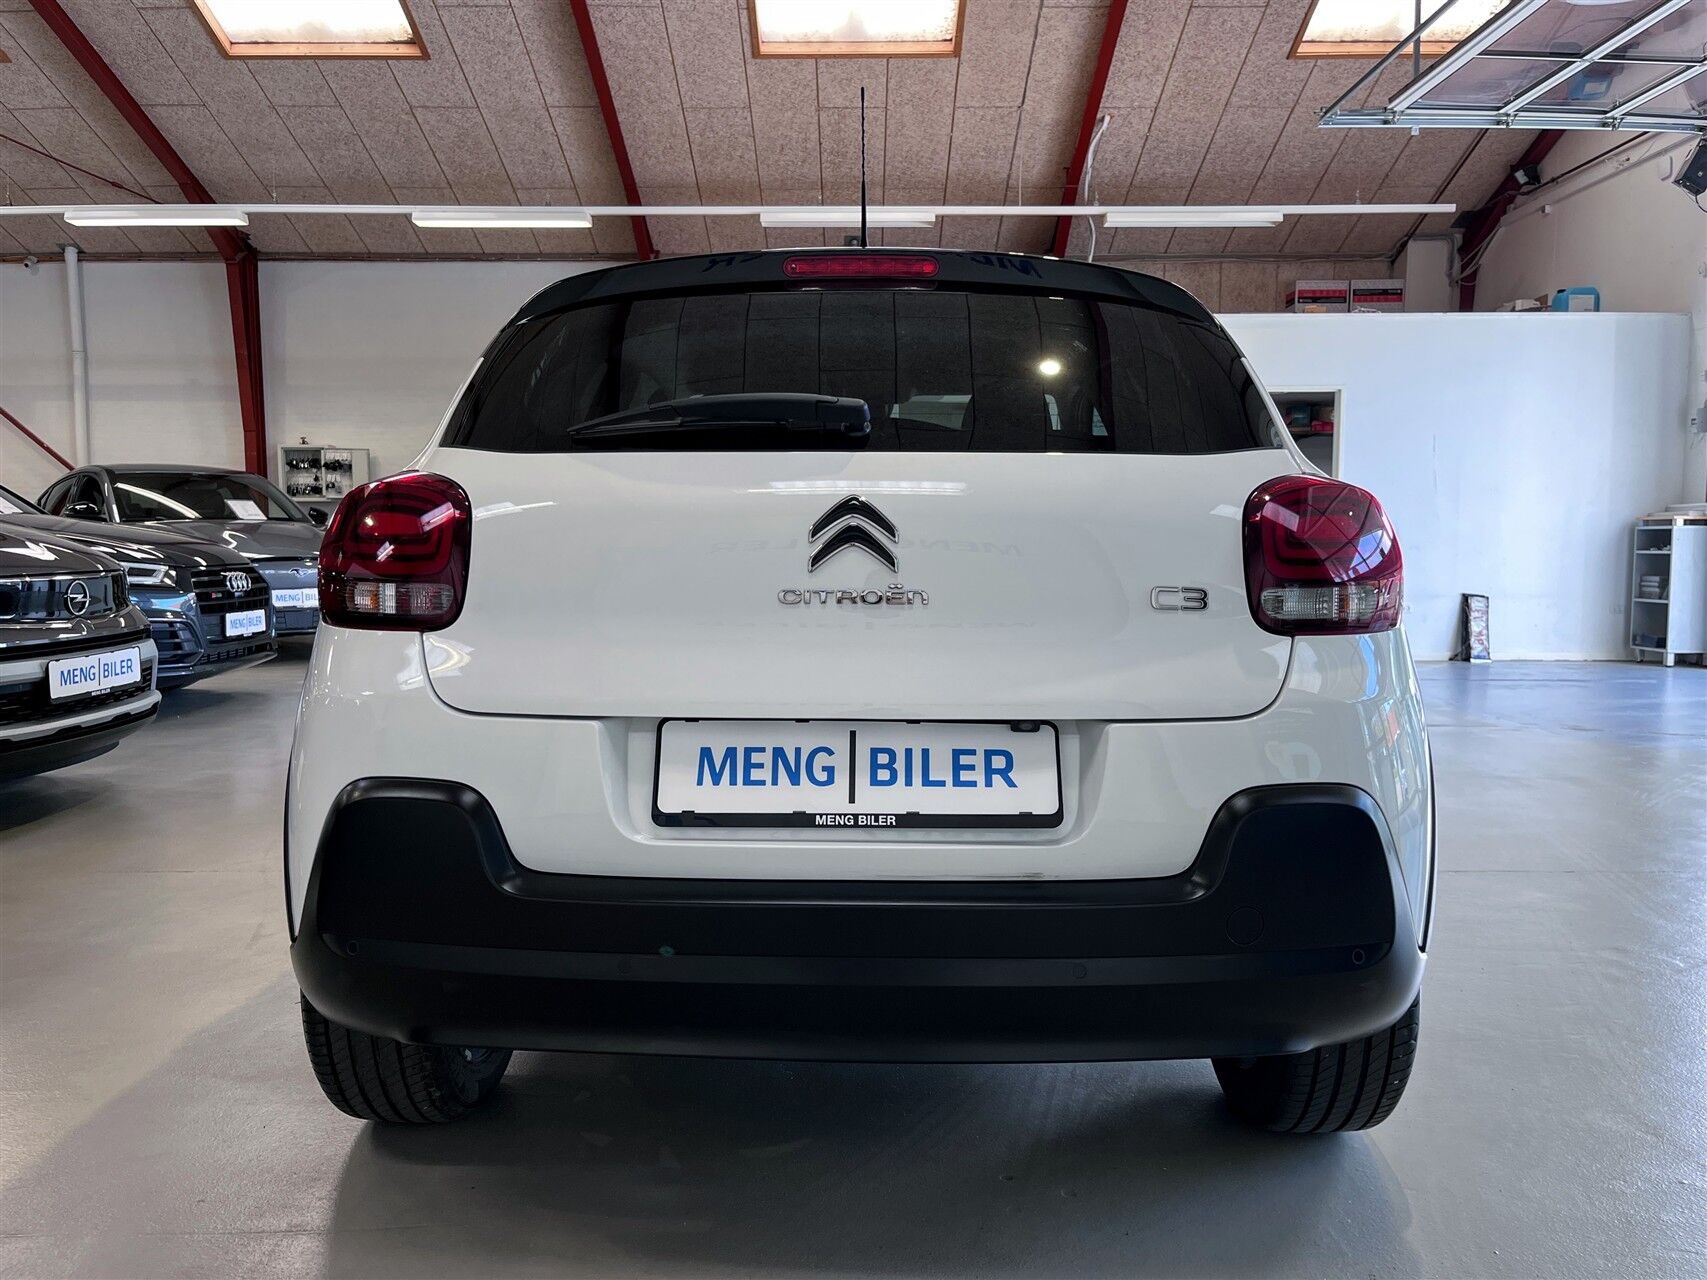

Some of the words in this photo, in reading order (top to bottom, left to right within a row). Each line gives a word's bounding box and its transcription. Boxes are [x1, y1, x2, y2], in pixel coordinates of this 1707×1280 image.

[275, 593, 301, 602] MENG
[305, 593, 318, 601] BIL
[1150, 586, 1209, 611] C3
[60, 665, 96, 687] MENG
[103, 658, 134, 679] BILER
[696, 746, 836, 787] MENG
[869, 747, 1018, 789] BILER
[815, 814, 854, 825] MENG
[858, 815, 896, 826] BILER
